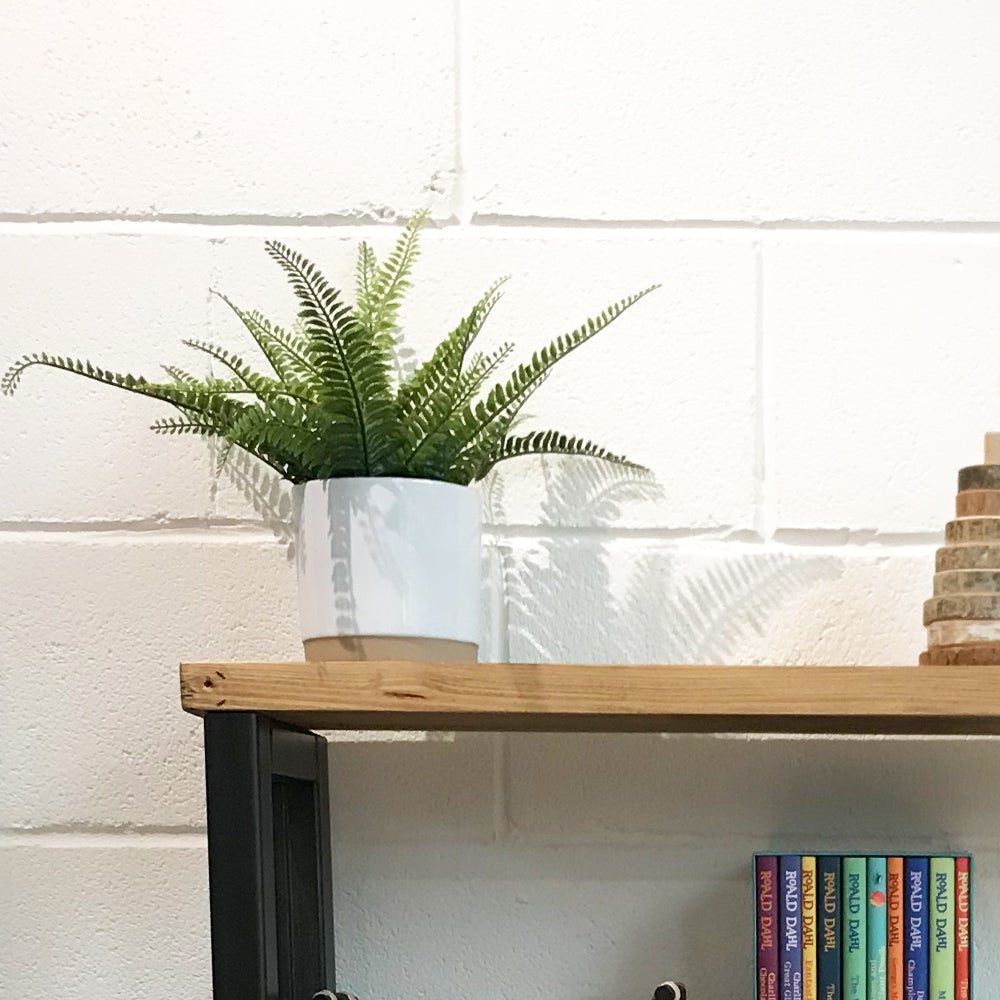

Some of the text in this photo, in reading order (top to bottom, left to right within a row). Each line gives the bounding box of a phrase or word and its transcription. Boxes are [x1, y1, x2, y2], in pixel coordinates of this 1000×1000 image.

[760, 871, 772, 950] ROALD DAHL
[785, 870, 797, 951] ROALD DAHL
[803, 870, 814, 950] ROALD DAHL
[824, 872, 836, 952] ROALD DAHL
[848, 873, 860, 953] ROALD DAHL
[890, 873, 899, 947] ROALD DAHL
[910, 871, 922, 952] ROALD DAHL
[936, 872, 948, 952] ROALD DAHL
[958, 871, 968, 952] ROALD DAHL
[852, 975, 860, 994] The
[960, 978, 968, 998] The
